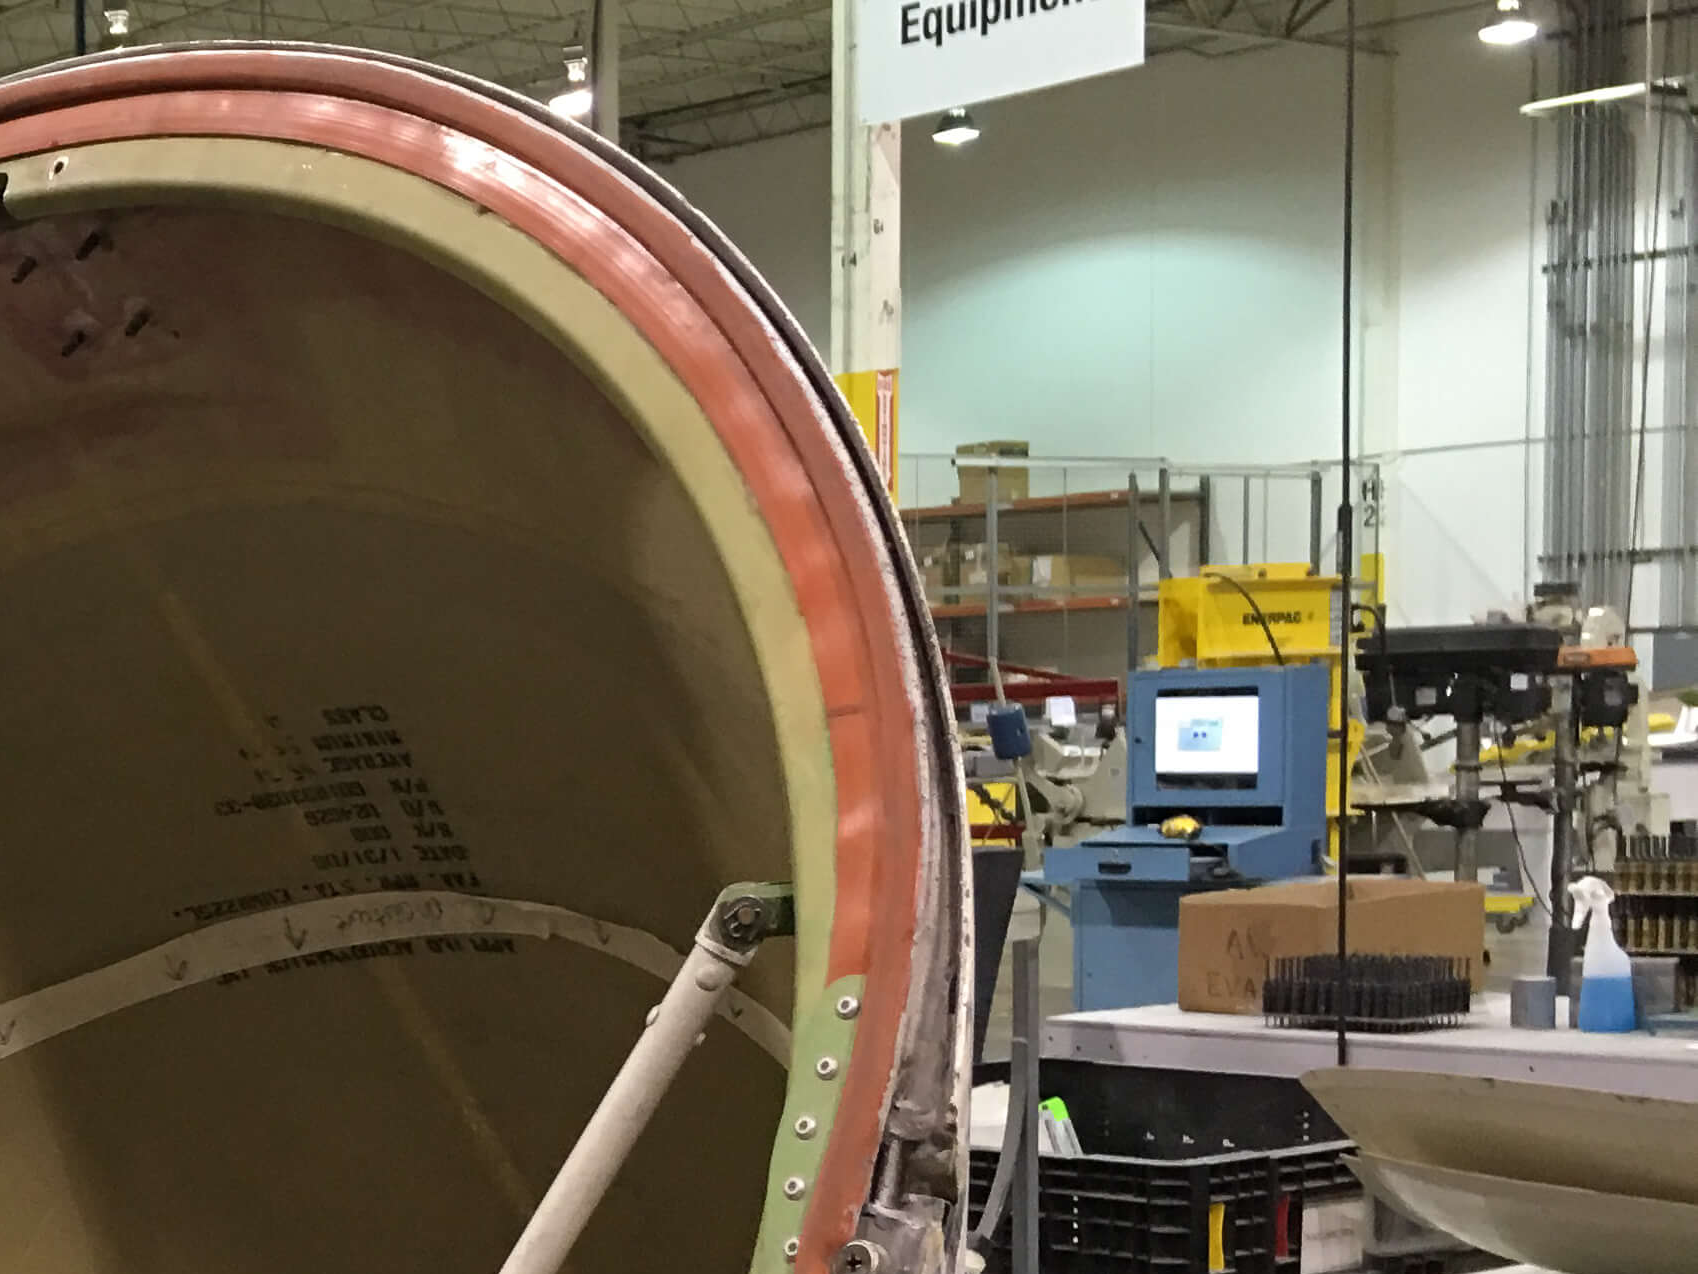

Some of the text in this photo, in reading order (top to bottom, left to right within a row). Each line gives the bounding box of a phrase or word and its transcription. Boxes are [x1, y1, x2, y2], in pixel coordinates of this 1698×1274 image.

[322, 704, 390, 727] CLASS
[311, 730, 403, 751] MINIMUM
[322, 751, 413, 773] AVERAGE
[411, 843, 468, 862] DATE
